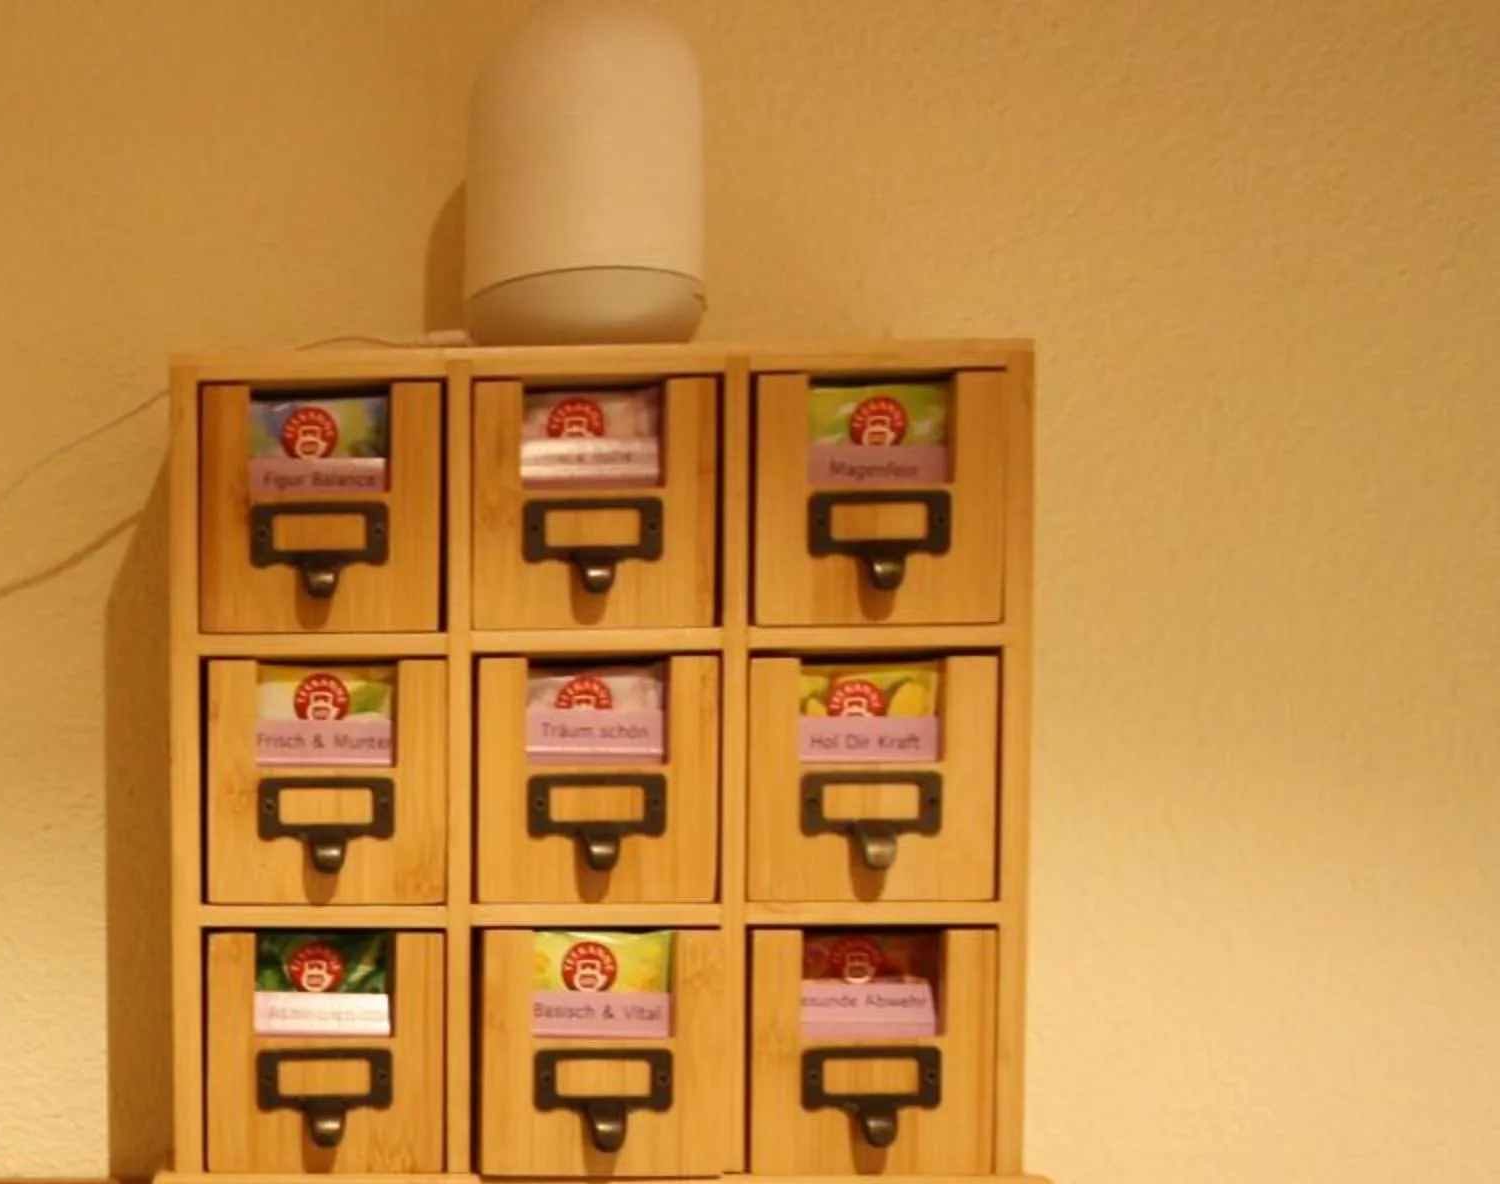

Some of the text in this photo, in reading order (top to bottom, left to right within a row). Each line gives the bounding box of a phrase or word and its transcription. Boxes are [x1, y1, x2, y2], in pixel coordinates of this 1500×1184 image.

[257, 732, 306, 749] Frisch
[312, 733, 326, 750] &
[877, 732, 922, 752] Kraft
[798, 995, 857, 1008] esunde
[532, 1002, 596, 1020] Basisch
[602, 1004, 616, 1020] &
